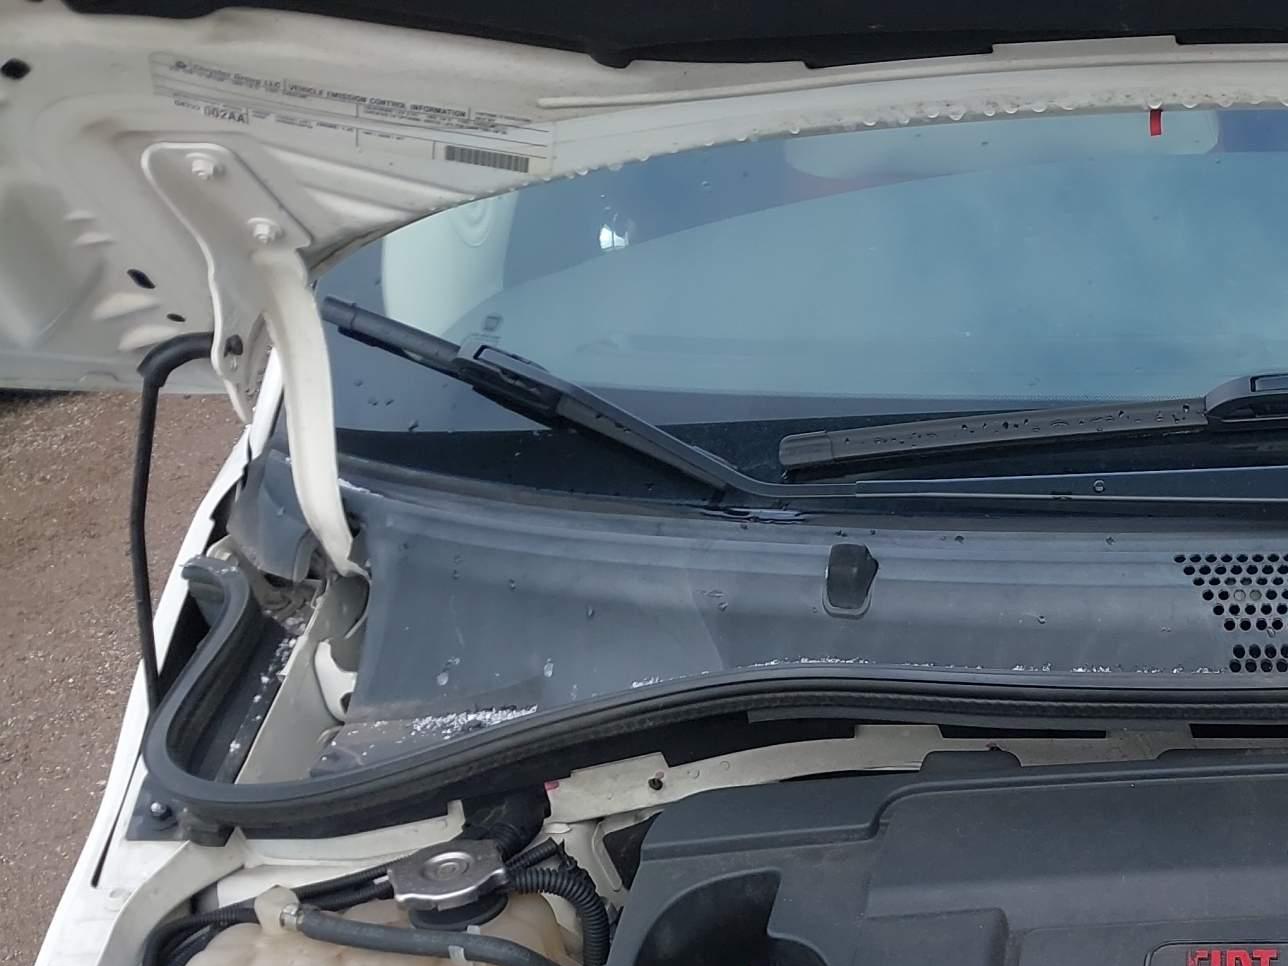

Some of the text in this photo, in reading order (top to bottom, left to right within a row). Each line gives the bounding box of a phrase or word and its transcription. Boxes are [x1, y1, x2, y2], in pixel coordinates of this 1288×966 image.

[289, 83, 323, 96] VEHICLE
[326, 90, 367, 103] EMISSION
[369, 96, 406, 109] CONTROL
[409, 103, 467, 118] INFORMATION
